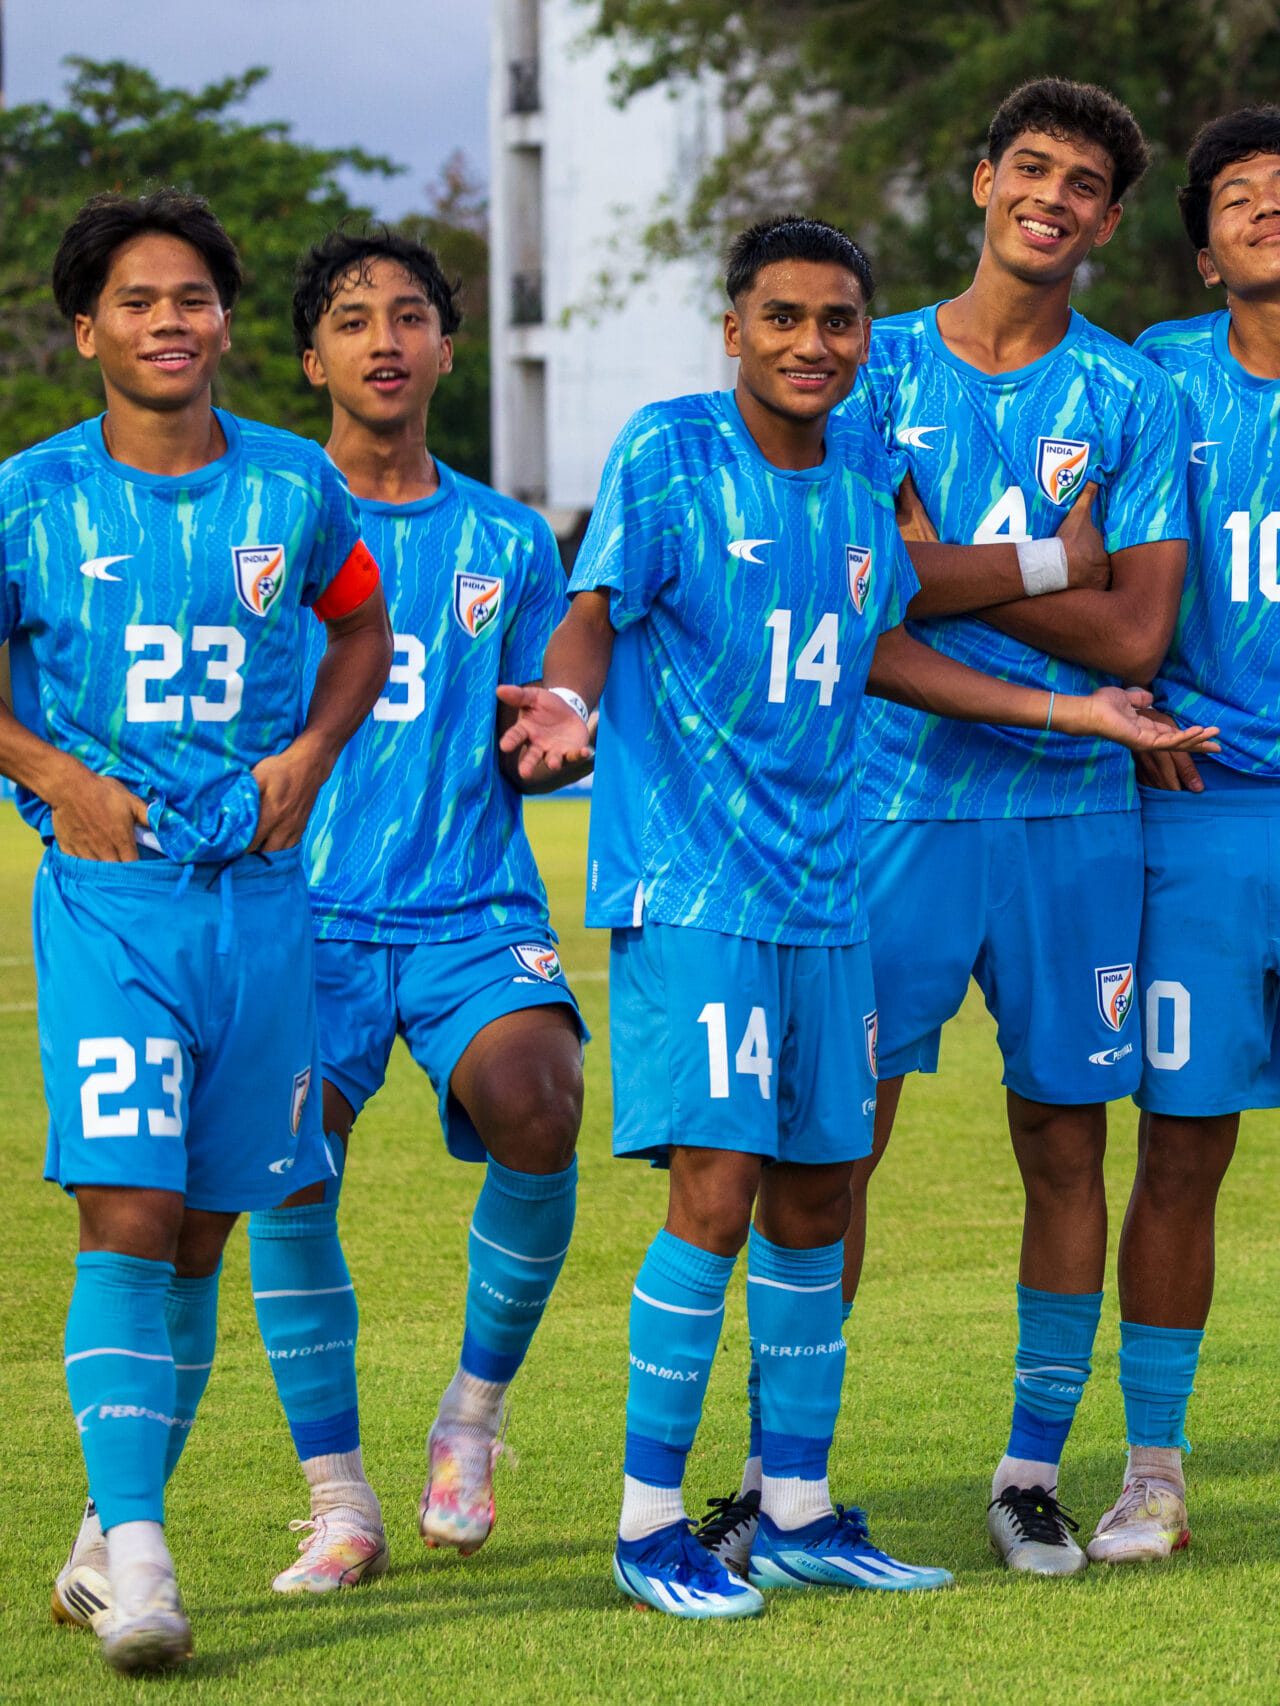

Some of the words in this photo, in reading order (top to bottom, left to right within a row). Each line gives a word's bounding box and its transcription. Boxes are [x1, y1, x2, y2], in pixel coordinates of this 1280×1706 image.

[1046, 445, 1073, 456] INDIA
[973, 486, 1033, 545] 4
[242, 554, 270, 563] INDIA
[462, 581, 486, 591] INDIA
[849, 553, 864, 563] INDIA
[125, 625, 246, 722] 23
[373, 634, 425, 721] 3
[765, 609, 841, 706] 14
[1103, 974, 1124, 983] INDIA
[697, 1003, 773, 1099] 14
[78, 1037, 182, 1139] 23
